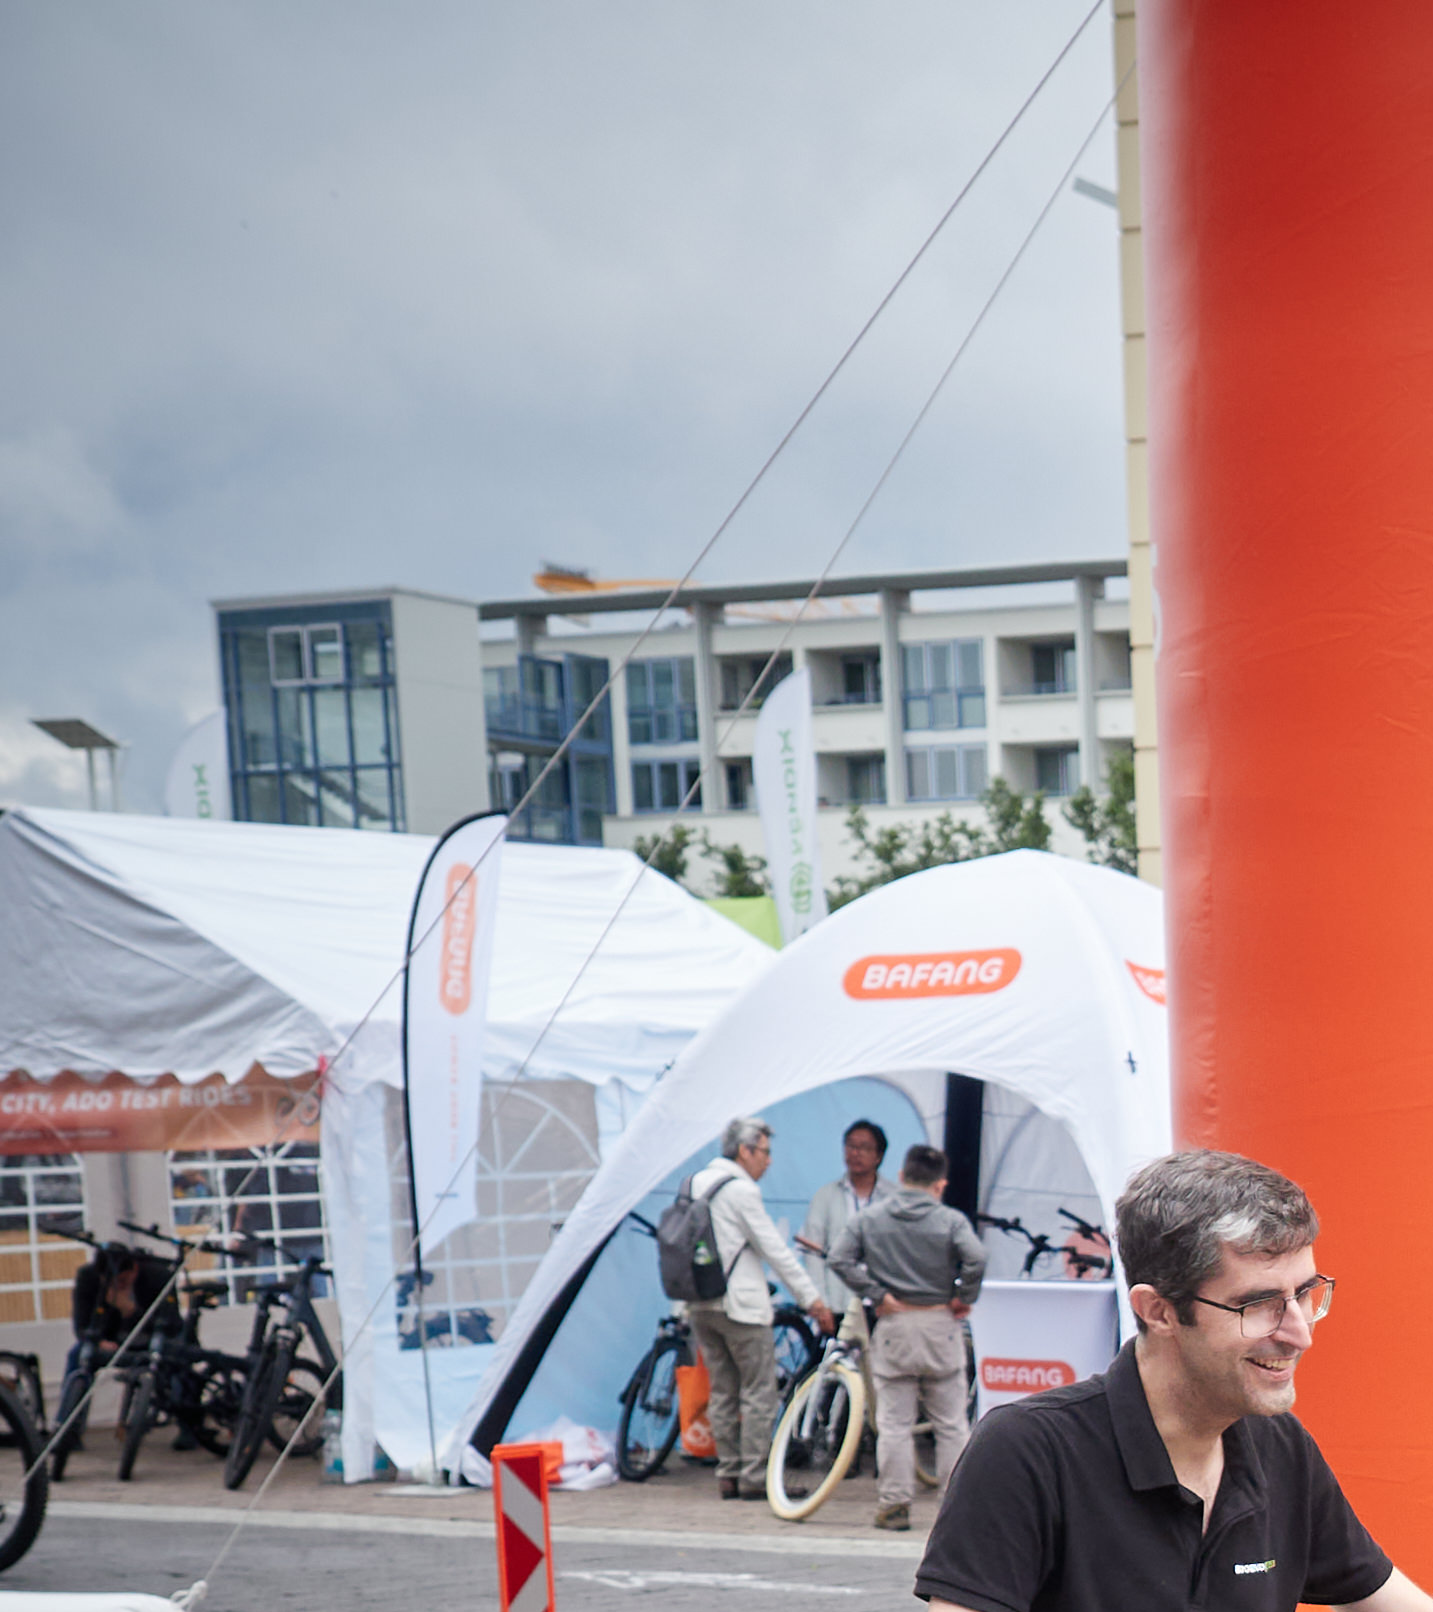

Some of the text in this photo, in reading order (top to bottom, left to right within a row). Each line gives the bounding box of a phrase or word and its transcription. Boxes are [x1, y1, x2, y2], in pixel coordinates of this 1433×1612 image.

[862, 957, 1004, 989] BAFANG
[120, 1089, 173, 1110] TEST
[984, 1365, 1064, 1387] BAFANG
